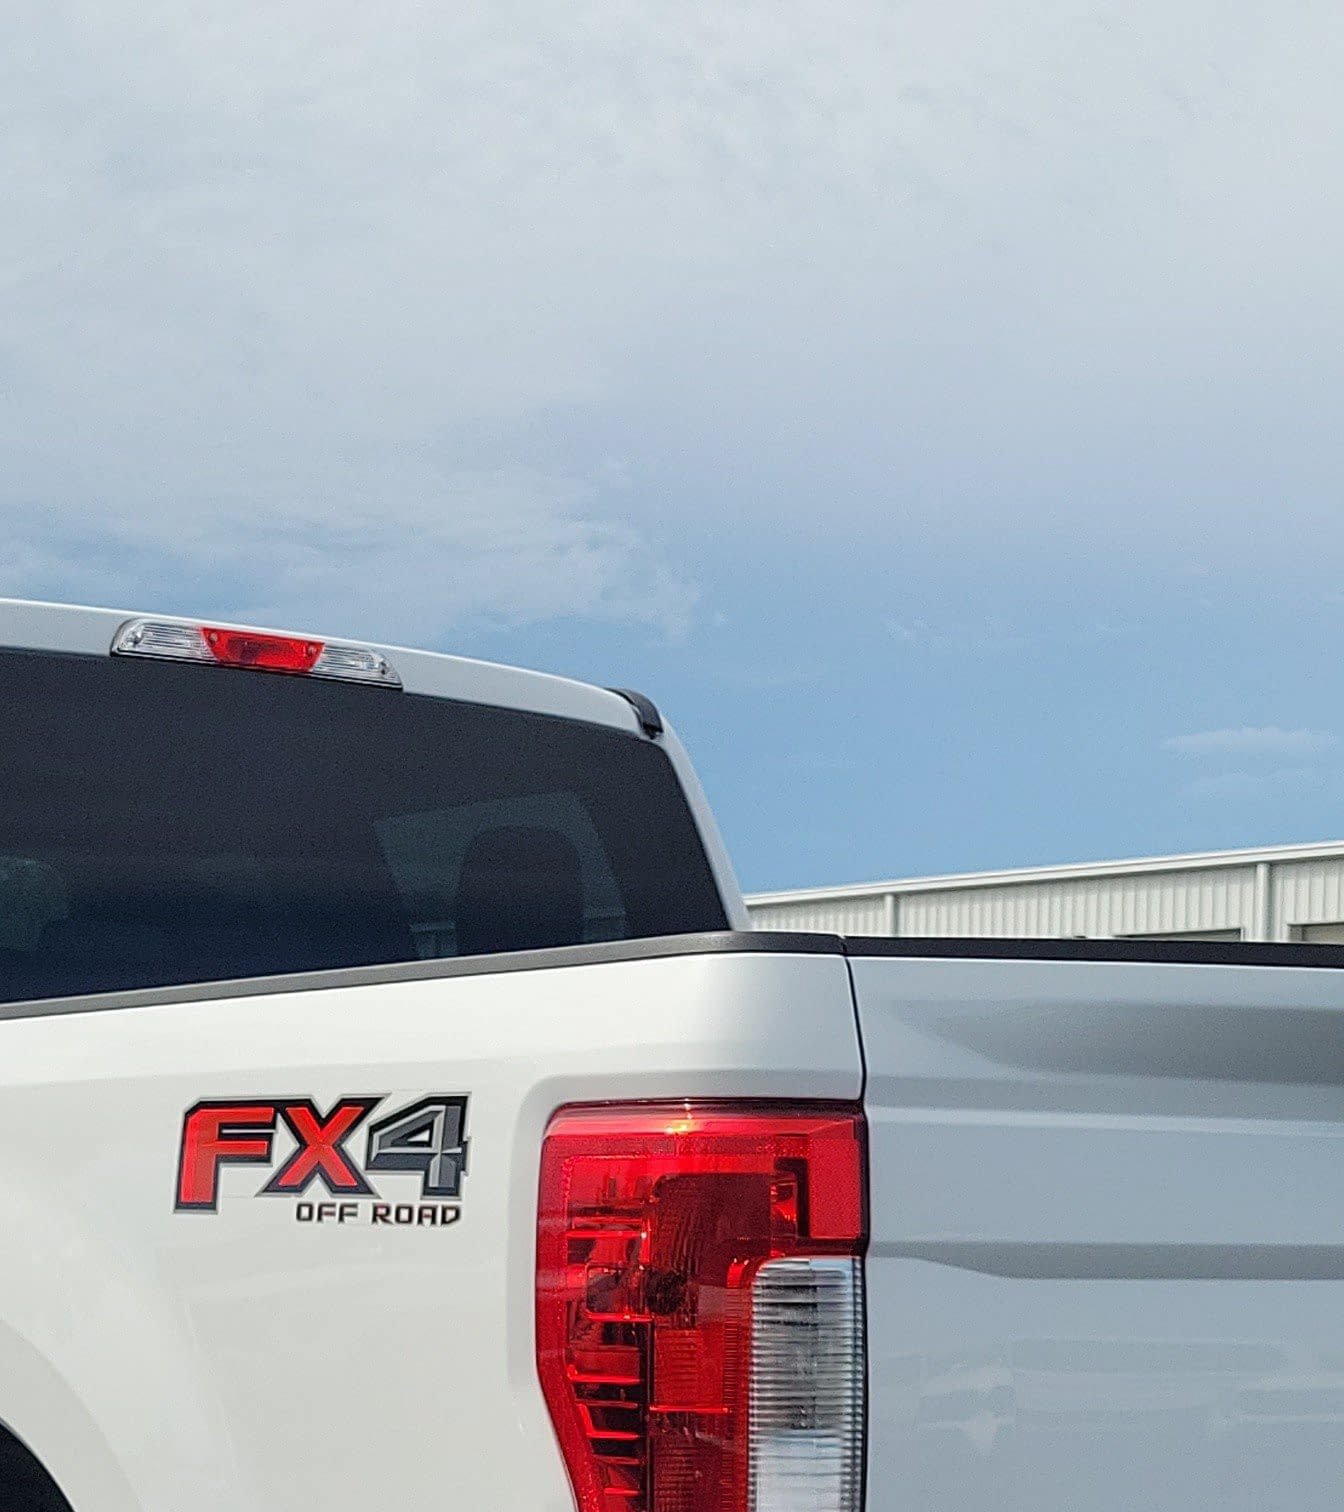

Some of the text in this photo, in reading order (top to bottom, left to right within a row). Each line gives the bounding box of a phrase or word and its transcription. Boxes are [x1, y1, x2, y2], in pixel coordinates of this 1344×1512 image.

[174, 1092, 472, 1214] FX4
[296, 1203, 462, 1226] OFF ROAD
